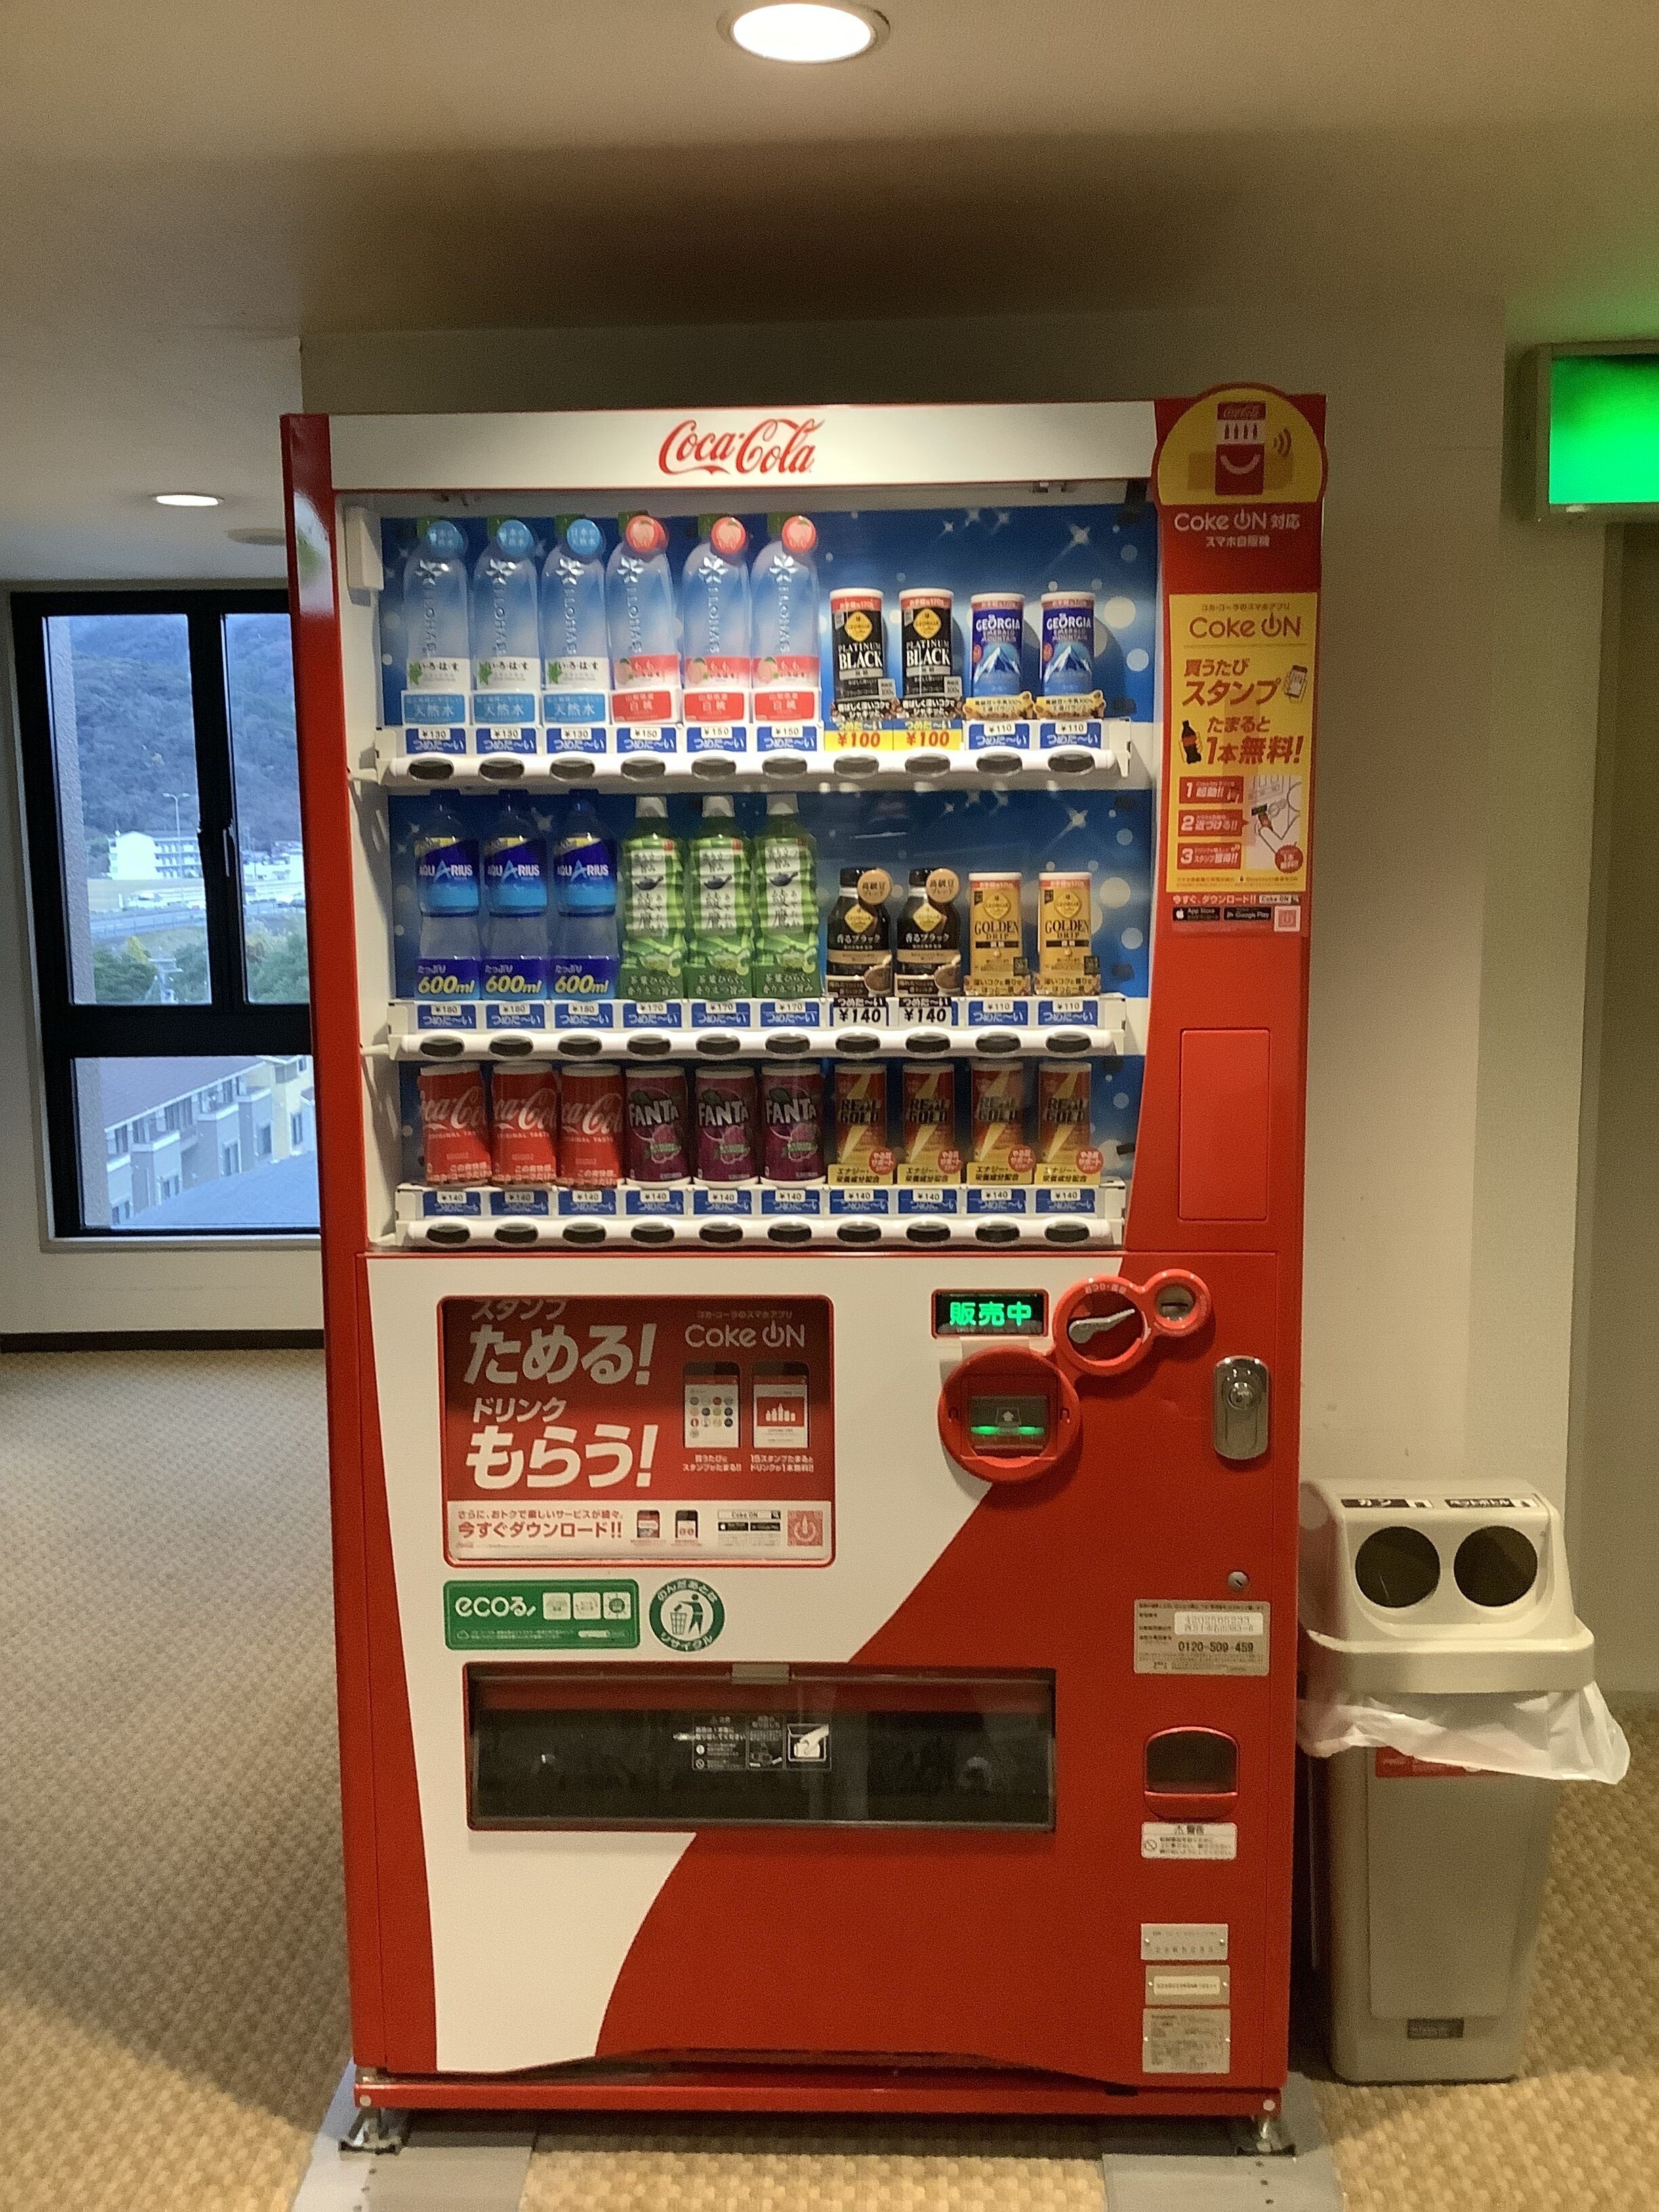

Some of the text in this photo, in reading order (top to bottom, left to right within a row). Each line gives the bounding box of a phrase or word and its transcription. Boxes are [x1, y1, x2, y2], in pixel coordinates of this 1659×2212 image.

[1174, 512, 1229, 531] Coke
[1234, 508, 1267, 529] ON
[976, 613, 1021, 631] GEORGIA
[1046, 613, 1091, 631] GEORGIA
[1189, 612, 1303, 638] Coke ON
[838, 642, 882, 652] PLATINUM
[906, 640, 949, 649] PLATINUM
[838, 651, 883, 670] BLACK
[906, 648, 950, 667] BLACK
[1184, 658, 1250, 677] 買うたび
[1182, 677, 1282, 706] スタンプ
[704, 727, 729, 735] ¥150
[775, 727, 799, 735] ¥150
[989, 724, 1011, 733] ¥110
[1061, 724, 1084, 732] ¥110
[1207, 716, 1271, 733] たまると
[838, 732, 880, 747] ¥100
[907, 731, 949, 746] ¥100
[1206, 735, 1304, 764] 1本無料!
[1181, 815, 1194, 832] 2
[1181, 848, 1193, 864] 3
[975, 921, 1019, 935] GOLDEN
[1045, 920, 1091, 935] GOLDEN
[1057, 932, 1080, 940] DRIP
[418, 975, 474, 994] 600ml
[485, 975, 541, 994] 600ml
[554, 975, 609, 994] 600ml
[839, 1008, 881, 1023] ¥140
[905, 1008, 947, 1023] ¥140
[628, 1100, 679, 1126] FANTA
[698, 1101, 749, 1126] FANTA
[766, 1099, 817, 1124] FANTA
[712, 1193, 735, 1201] ¥140
[780, 1192, 802, 1200] ¥140
[949, 1301, 1032, 1326] 販売中
[684, 1320, 805, 1348] Coke ON
[464, 1323, 657, 1385] ためる!
[473, 1397, 567, 1423] ドリンク
[466, 1424, 659, 1490] もらう!
[458, 1521, 621, 1538] 今すぐダウンロード!!
